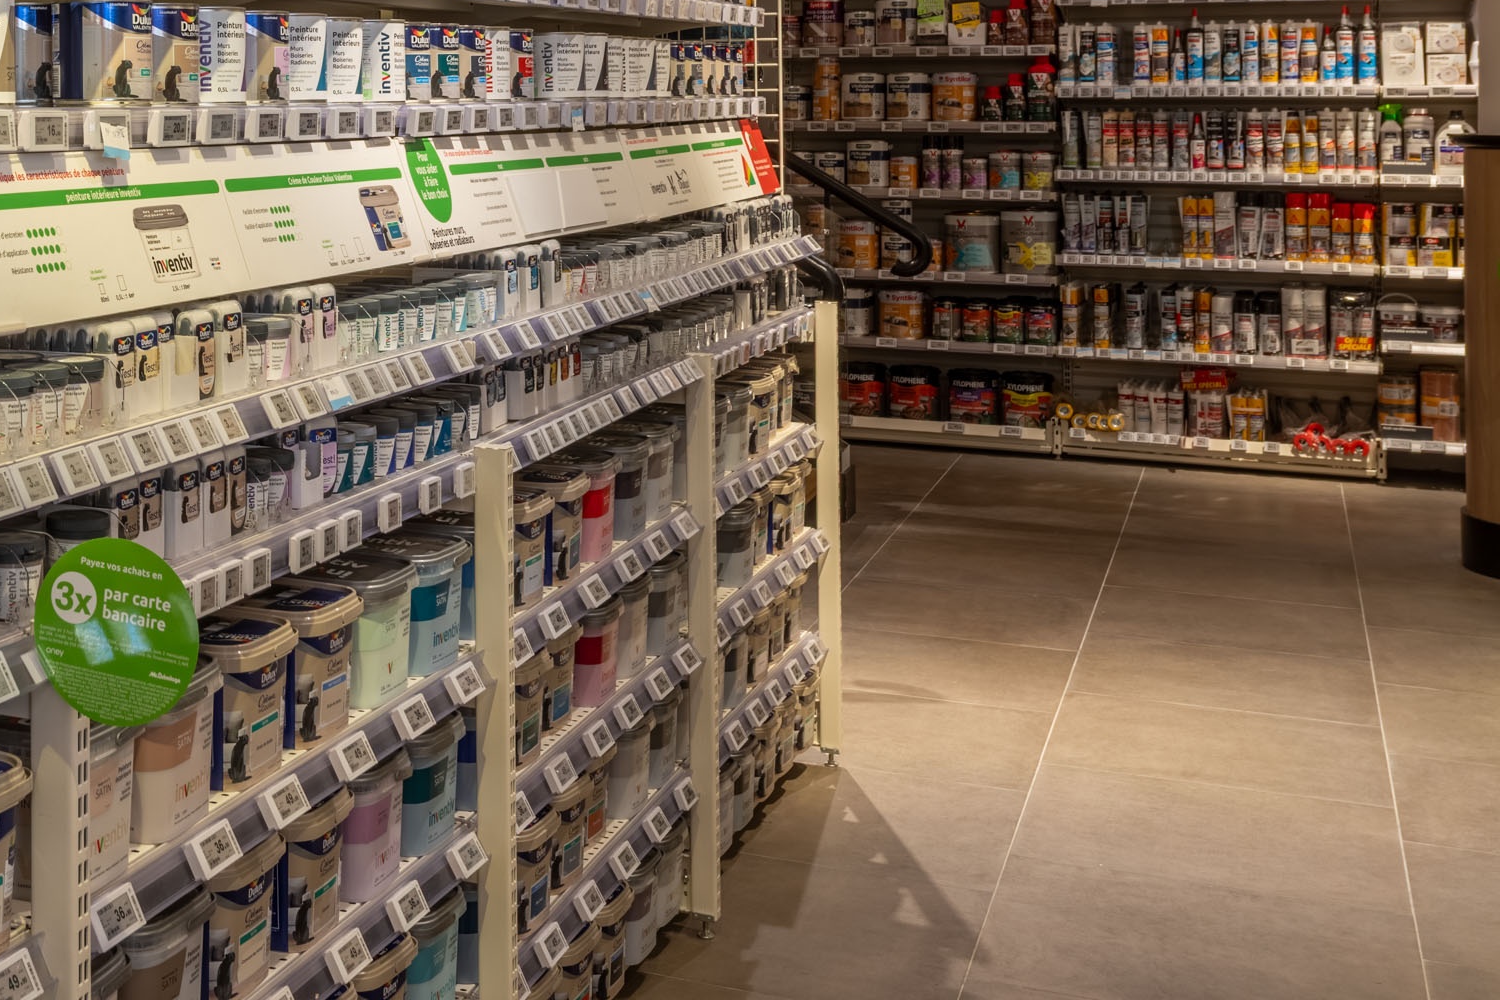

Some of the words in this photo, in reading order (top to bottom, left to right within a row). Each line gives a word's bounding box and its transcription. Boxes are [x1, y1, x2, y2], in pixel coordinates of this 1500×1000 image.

[15, 170, 26, 182] les
[72, 168, 81, 178] de
[80, 168, 101, 179] chaque
[100, 166, 125, 178] peinture
[151, 252, 193, 274] inventiv
[80, 556, 105, 569] Payez
[106, 563, 121, 572] vos
[122, 565, 151, 579] achats
[152, 571, 163, 581] en
[54, 580, 92, 616] 3x
[103, 588, 129, 602] par
[132, 593, 172, 613] carte
[102, 603, 167, 632] bancaire
